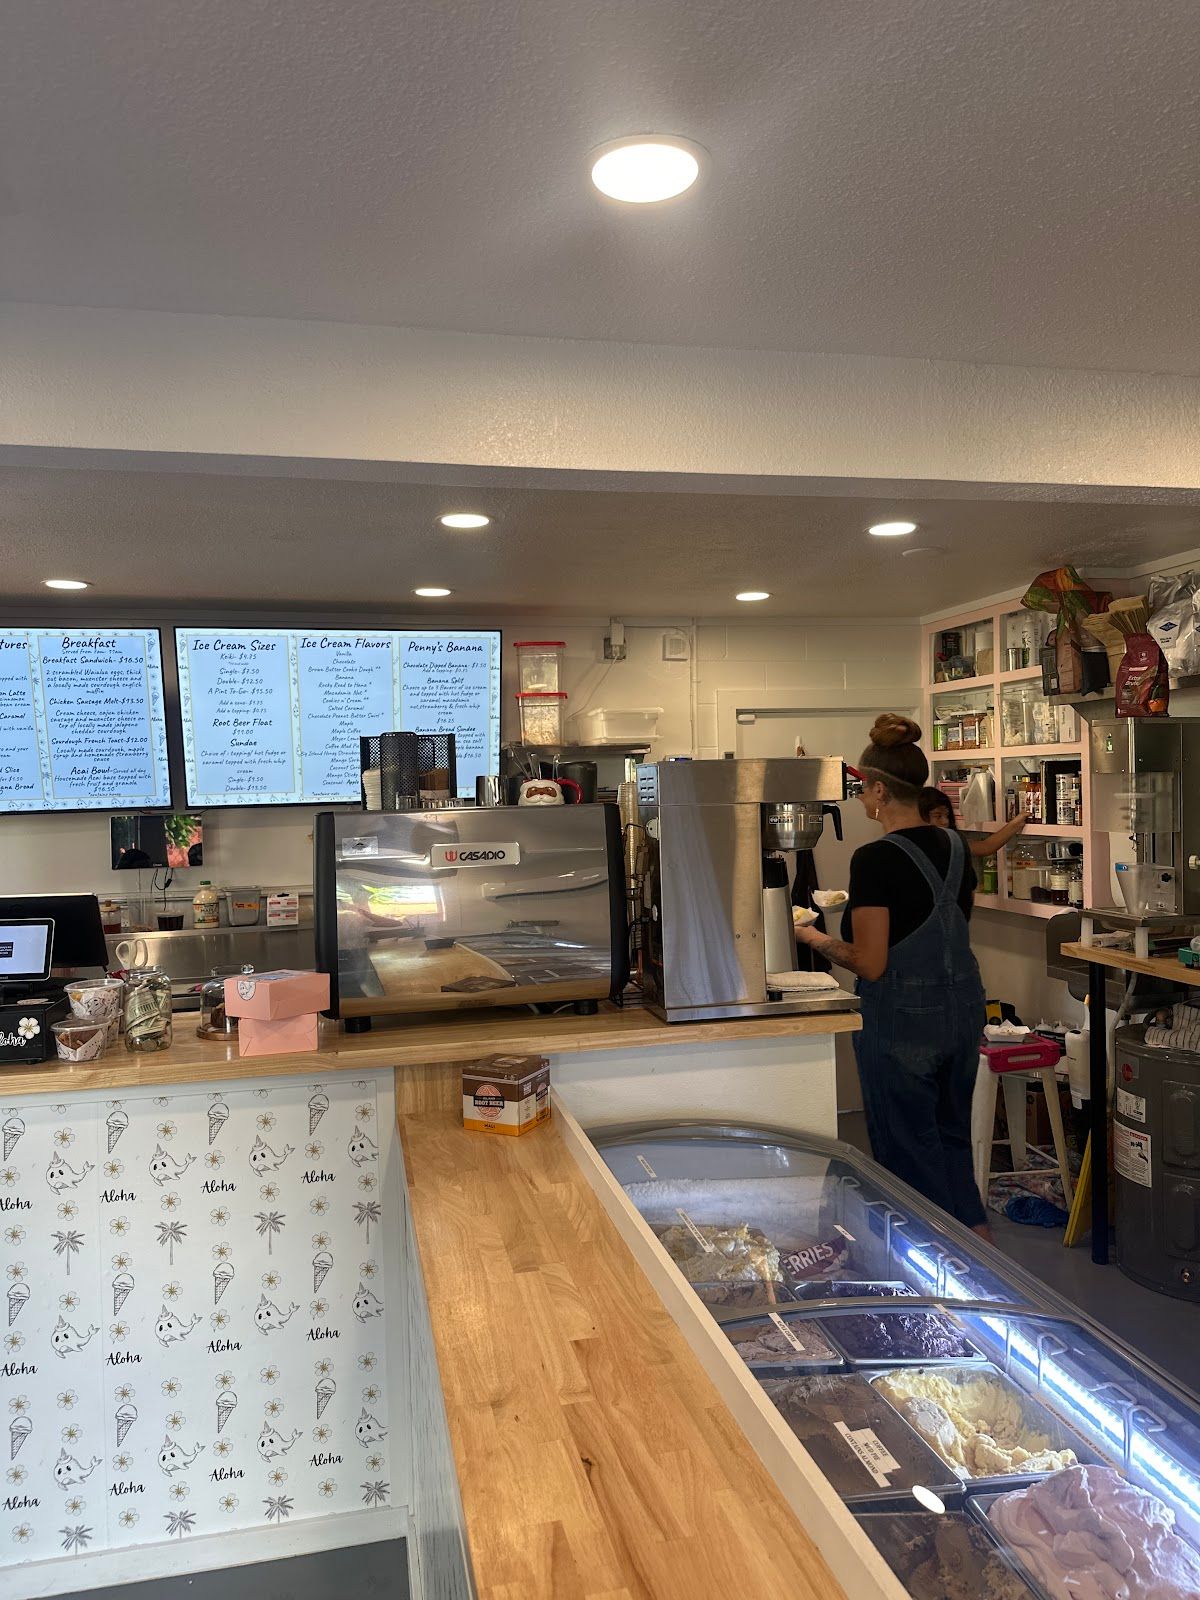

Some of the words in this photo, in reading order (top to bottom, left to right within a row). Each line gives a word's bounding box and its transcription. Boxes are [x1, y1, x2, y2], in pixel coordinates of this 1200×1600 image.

[62, 637, 116, 649] Breakfast
[192, 640, 210, 651] Ice
[214, 640, 246, 651] Cream
[250, 640, 276, 651] Sizes
[300, 638, 317, 648] Ice
[320, 638, 351, 648] Cream
[355, 638, 391, 648] Flavors
[408, 641, 443, 654] Penny's
[446, 642, 483, 652] Banana
[42, 656, 77, 664] Breakfast
[119, 656, 143, 664] $16.50
[100, 709, 114, 717] cajun
[212, 718, 230, 727] Root
[233, 718, 250, 727] Beer
[252, 718, 272, 726] Float
[52, 737, 82, 745] Sourdough
[230, 739, 257, 747] Sundae
[71, 766, 89, 775] Acai
[460, 850, 505, 861] CASADIO
[301, 1170, 336, 1183] Aloha
[202, 1180, 236, 1193] Aloha
[100, 1189, 136, 1203] Aloha
[306, 1327, 339, 1340] Aloha
[208, 1339, 242, 1353] Aloha
[105, 1352, 142, 1365] Aloha
[0, 1362, 36, 1376] Aloha
[873, 1440, 888, 1456] COFFEE
[309, 1453, 342, 1466] Aloha
[211, 1467, 245, 1481] Aloha
[109, 1482, 144, 1496] Aloha
[2, 1496, 39, 1510] Aloha
